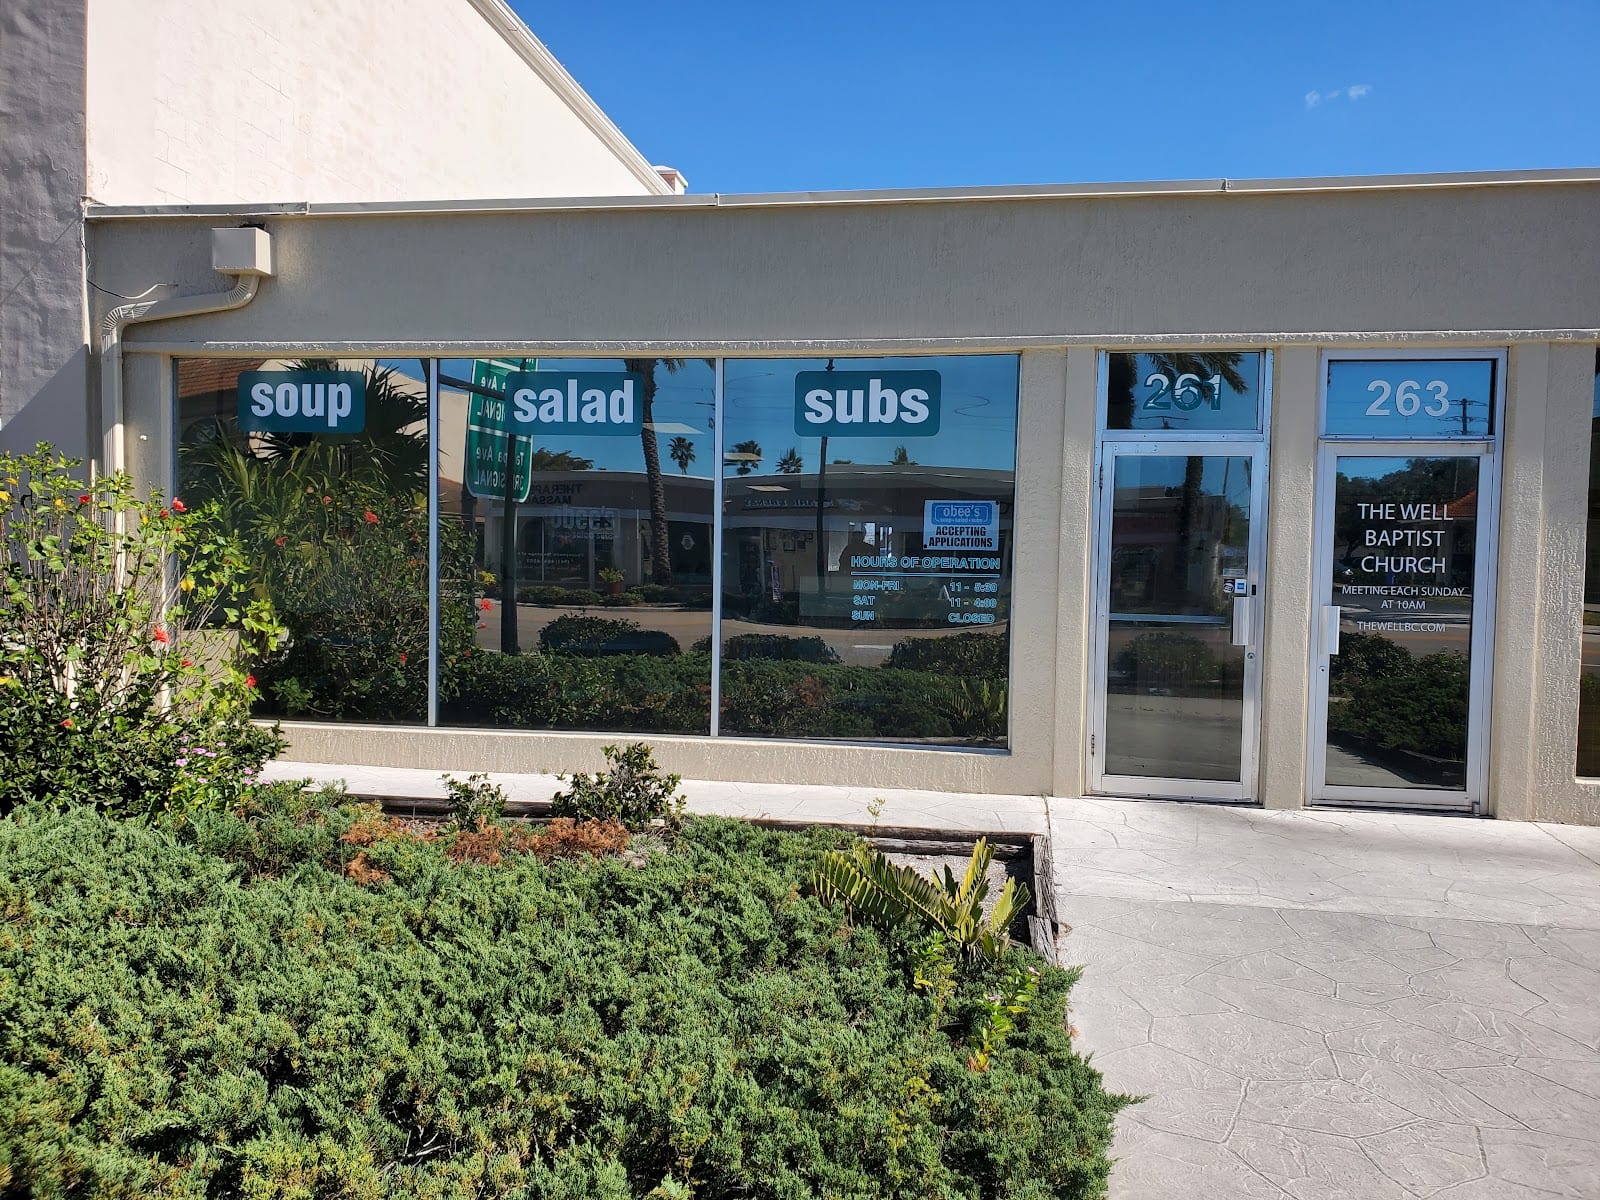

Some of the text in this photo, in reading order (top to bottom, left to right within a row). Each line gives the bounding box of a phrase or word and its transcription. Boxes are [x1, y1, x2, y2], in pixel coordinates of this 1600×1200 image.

[1142, 372, 1222, 411] 261
[1365, 379, 1450, 417] 263
[251, 382, 351, 427] soup
[513, 379, 634, 424] salad
[804, 378, 930, 424] subs
[943, 504, 980, 517] obee's
[1357, 503, 1454, 521] THE WELL
[936, 526, 986, 536] ACCEPTING
[929, 536, 993, 548] APPLICATIONS
[1365, 530, 1445, 547] BAPTIST
[850, 555, 1000, 570] HOURS OF OPERATION
[1361, 556, 1446, 574] CHURCH
[853, 580, 899, 591] MON-FRI
[1342, 586, 1465, 597] MEETING EACH SUNDAY
[853, 595, 875, 606] SAT
[1381, 600, 1426, 610] AT 10AM
[851, 610, 996, 624] SUN CLOSED
[1357, 621, 1446, 632] THEWELLBC.COM
